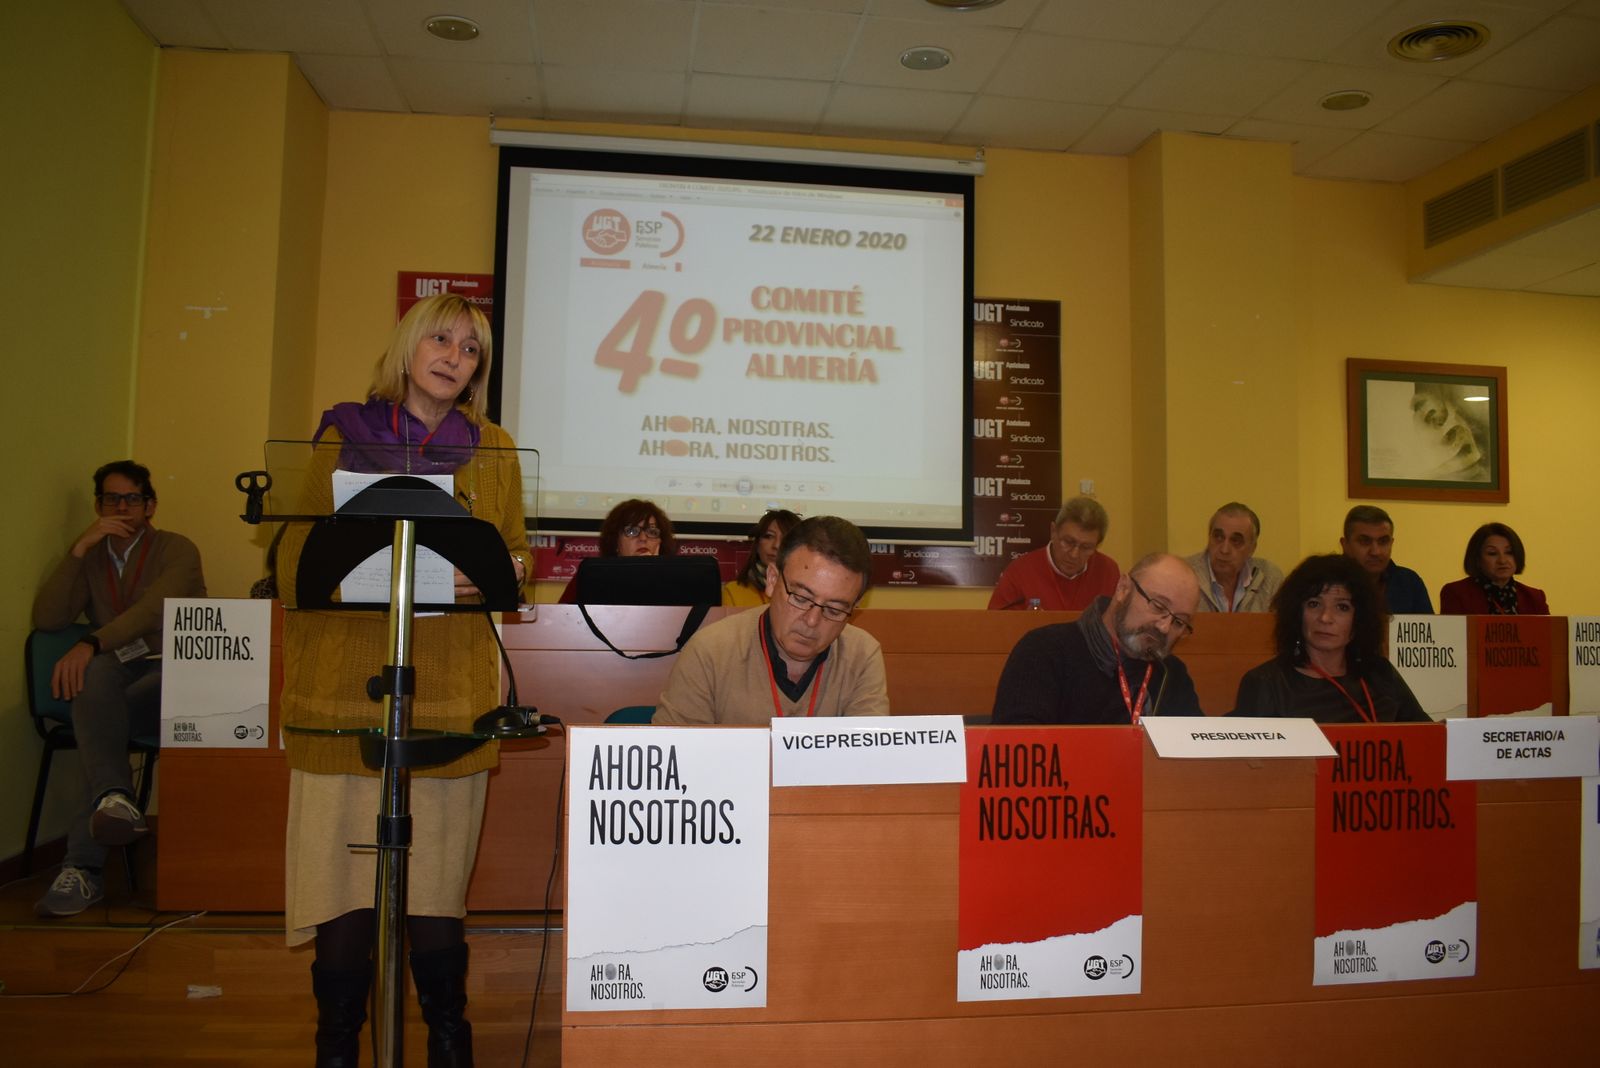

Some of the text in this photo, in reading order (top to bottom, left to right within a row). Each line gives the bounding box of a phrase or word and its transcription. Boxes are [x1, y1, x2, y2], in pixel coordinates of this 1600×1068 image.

[748, 223, 907, 251] 22 ENERO 2020
[750, 284, 865, 317] COMITÉ
[973, 302, 1005, 323] UGT
[722, 317, 903, 351] PROVINCIAL
[1009, 318, 1045, 329] Sindicato
[745, 351, 878, 384] ALMERÍA
[973, 360, 1005, 380] UGT
[1009, 376, 1045, 386] Sindicato
[727, 417, 835, 440] NOSOTRAS.
[973, 418, 1005, 439] UGT
[1010, 434, 1045, 444] Sindicato
[724, 442, 836, 464] NOSOTROS.
[973, 476, 1005, 497] UGT
[1010, 492, 1046, 502] Sindicato
[679, 544, 718, 555] Sindicato
[973, 535, 1005, 556] UGT
[173, 606, 227, 634] AHORA,
[1396, 622, 1436, 645] AHORA,
[173, 635, 254, 661] NOSOTRAS.
[1397, 646, 1457, 668] NOSOTROS.
[782, 729, 957, 751] VICEPRESIDENTE/A
[1190, 731, 1287, 742] PRESIDENTE/A
[1482, 730, 1566, 743] SECRETARIO/A
[1331, 739, 1413, 785] AHORA,
[1496, 747, 1552, 760] DE ACTAS
[589, 743, 688, 795] AHORA,
[978, 743, 1070, 792] AHORA,
[978, 794, 1117, 841] NOSOTRAS.
[1332, 788, 1456, 833] NOSOTROS.
[589, 799, 742, 846] NOSOTROS.
[1086, 959, 1105, 970] UGT
[1333, 957, 1379, 976] NOSOTROS.
[705, 970, 727, 982] UGT
[980, 972, 1030, 990] NOSOTRAS.
[590, 982, 646, 1000] NOSOTROS.
